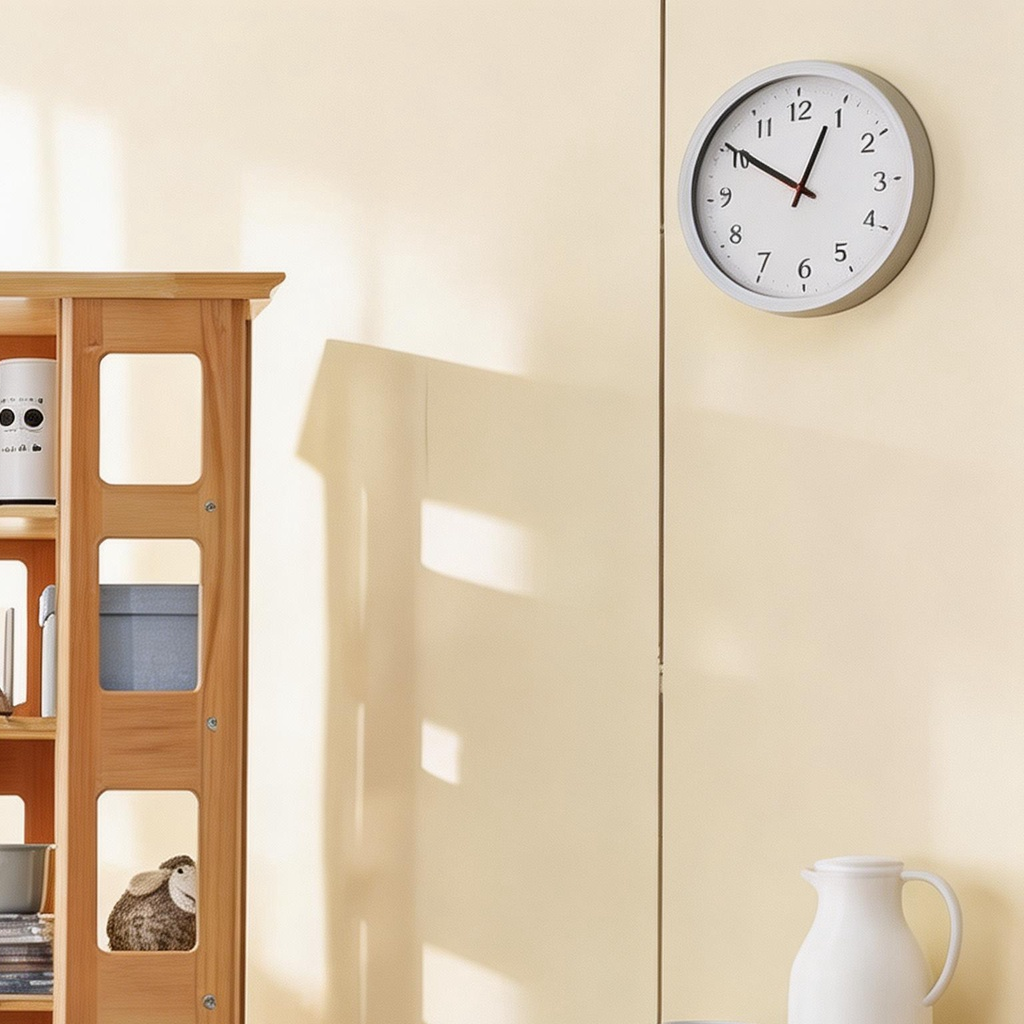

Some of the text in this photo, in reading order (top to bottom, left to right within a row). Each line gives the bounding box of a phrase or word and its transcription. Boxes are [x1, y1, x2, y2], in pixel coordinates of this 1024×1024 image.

[787, 100, 812, 122] 12
[835, 108, 842, 128] 1
[757, 117, 772, 138] 11
[861, 133, 875, 153] 2
[732, 149, 750, 169] 10
[873, 171, 886, 191] 3
[719, 187, 732, 208] 9
[862, 209, 875, 227] 4
[729, 224, 742, 244] 8
[757, 252, 772, 273] 7
[834, 243, 848, 262] 5
[798, 258, 812, 279] 6
